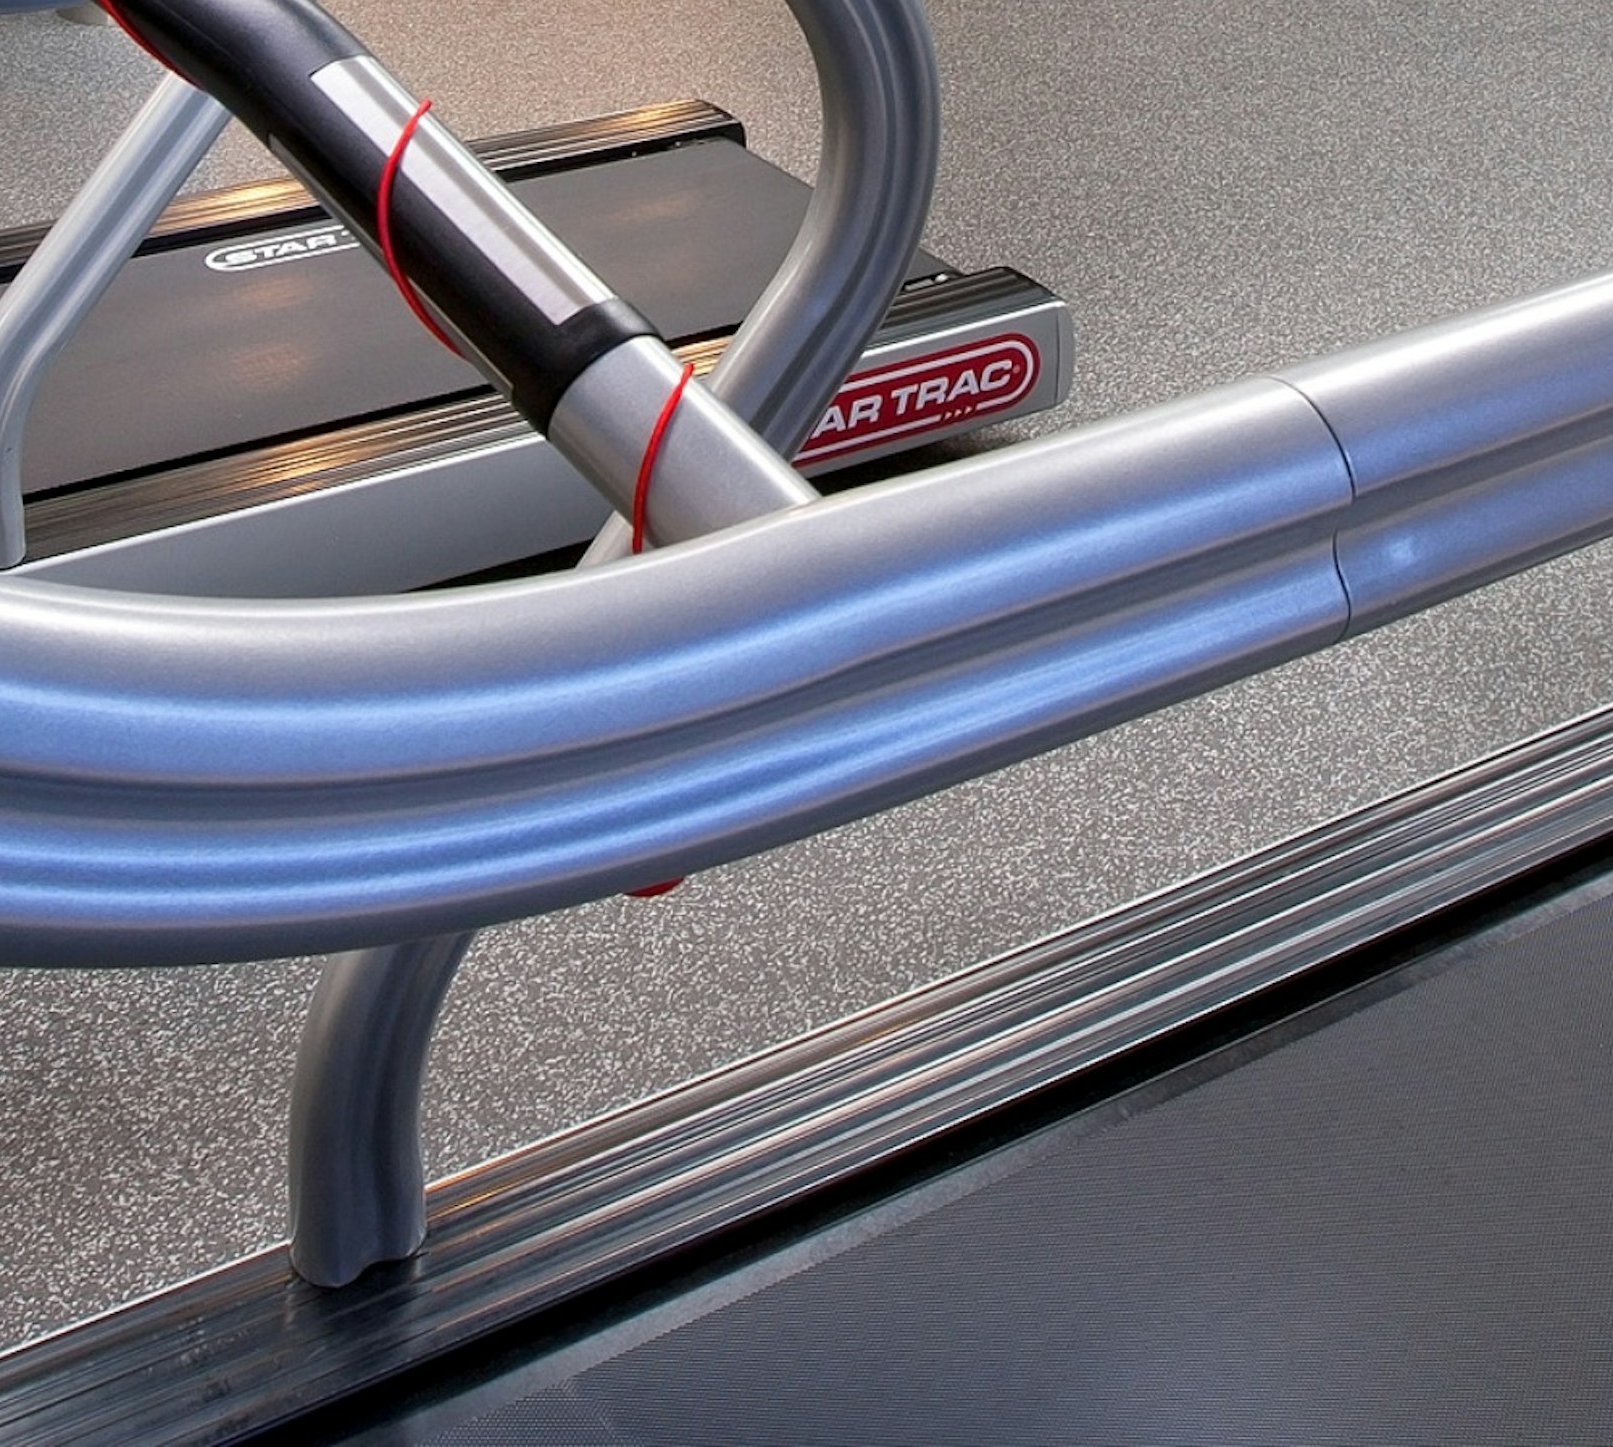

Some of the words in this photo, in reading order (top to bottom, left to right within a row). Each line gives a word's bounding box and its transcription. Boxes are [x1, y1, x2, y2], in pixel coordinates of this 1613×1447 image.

[225, 234, 337, 265] STAR
[811, 394, 883, 439] AR
[890, 359, 1013, 415] TRAC
